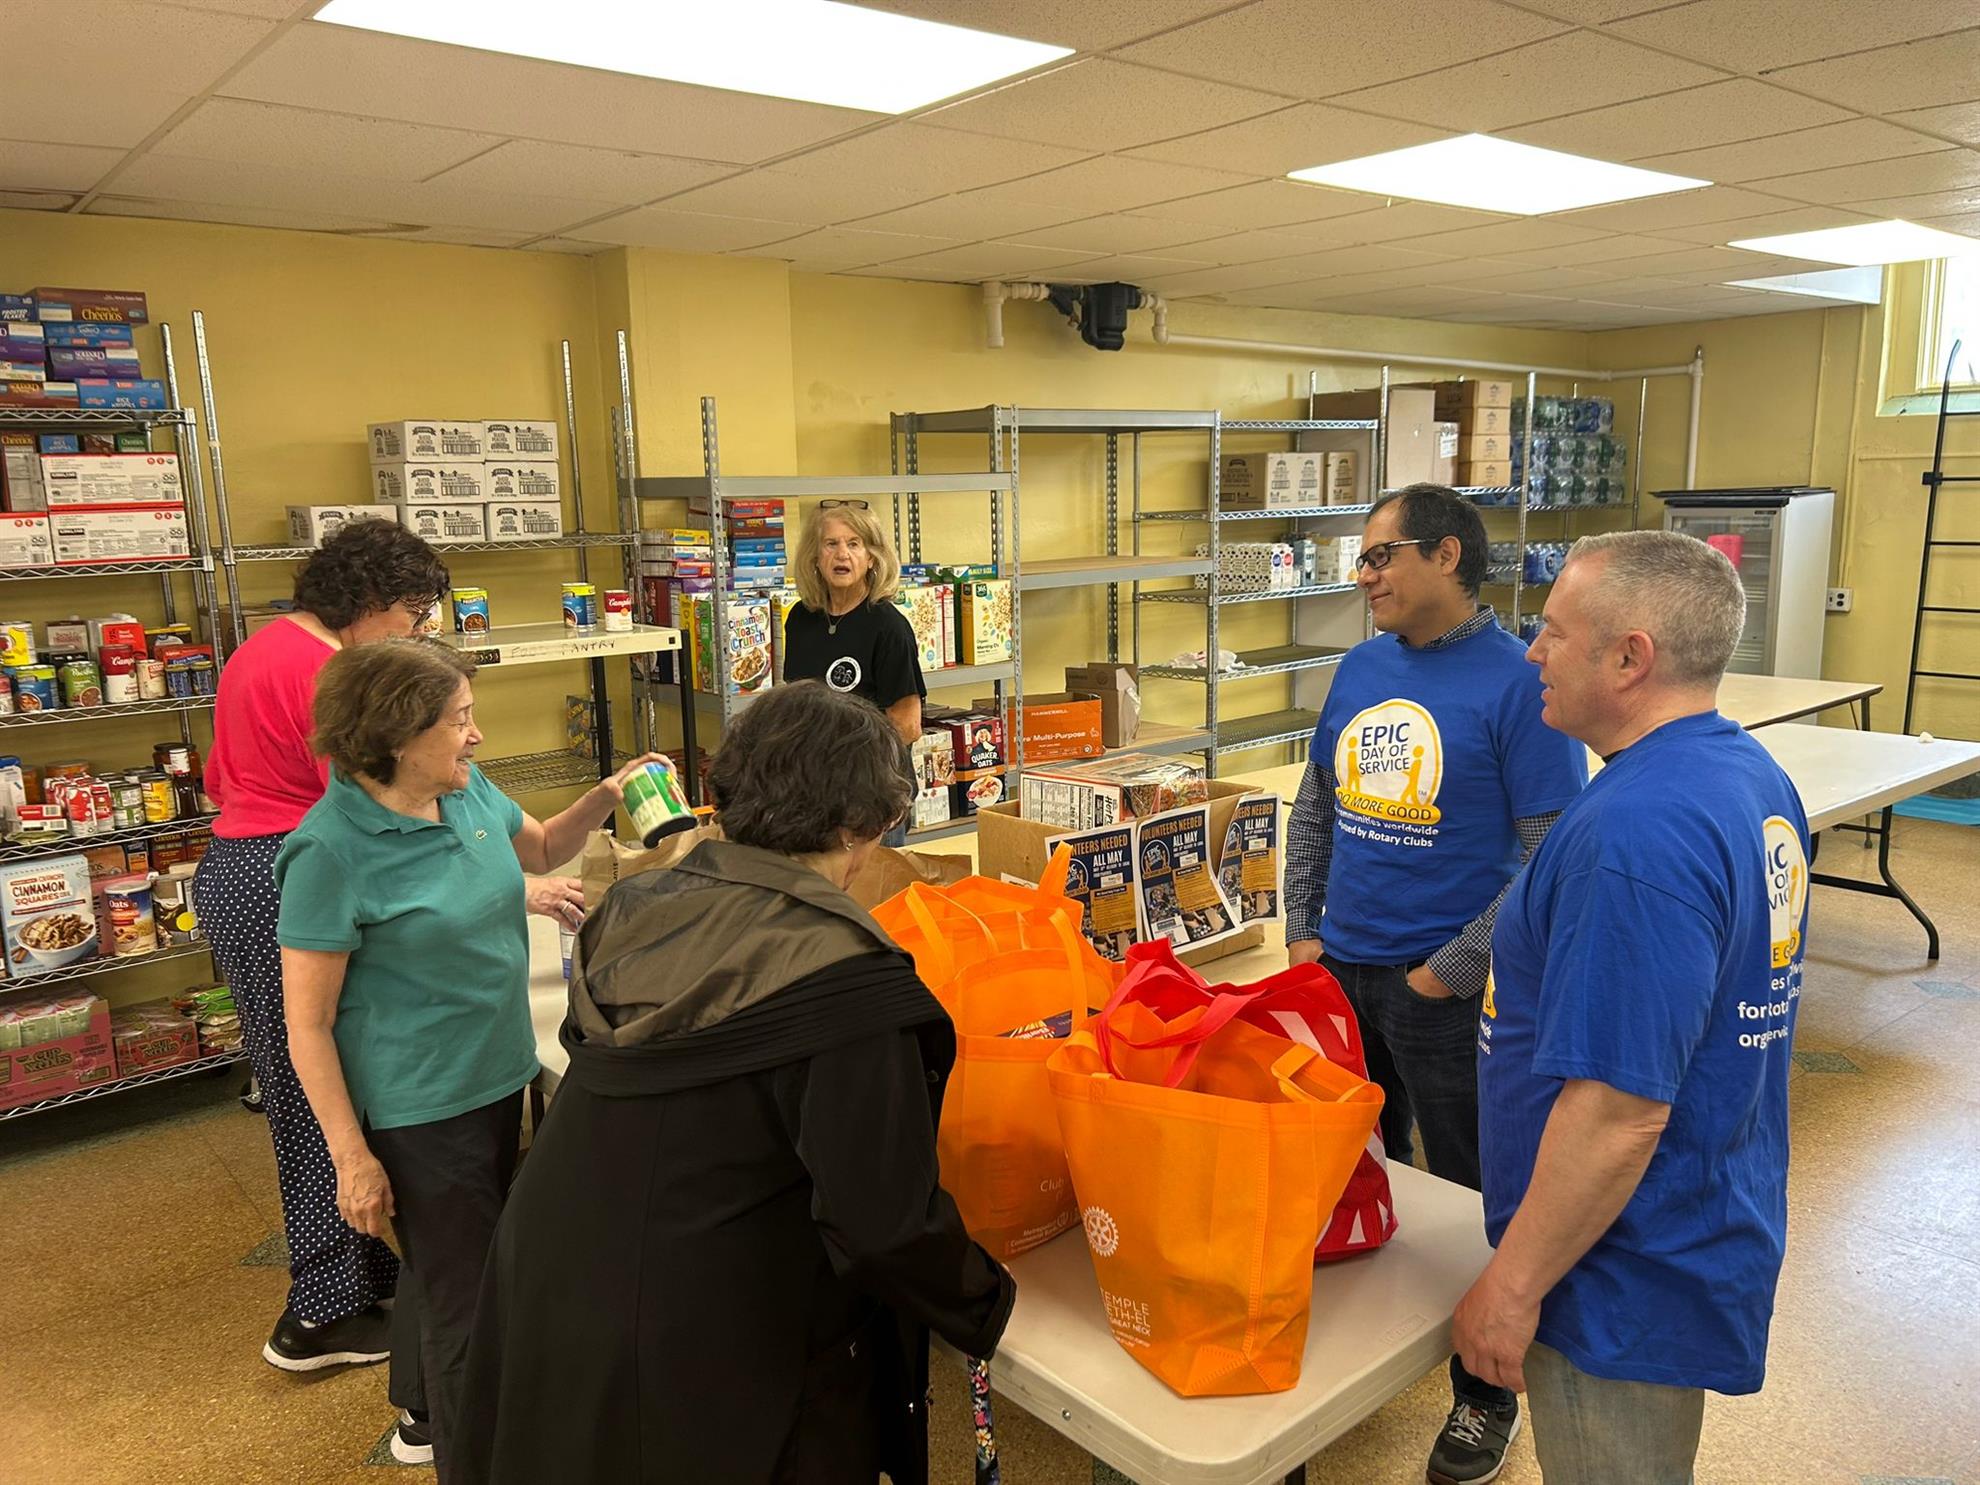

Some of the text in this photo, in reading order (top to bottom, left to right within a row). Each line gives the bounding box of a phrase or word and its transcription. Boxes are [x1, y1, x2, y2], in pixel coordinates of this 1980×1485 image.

[81, 308, 123, 321] Cheerios
[728, 613, 765, 629] Cinnamon
[733, 622, 760, 637] Toast
[561, 640, 616, 656] PANTRY
[730, 629, 766, 651] Crunch
[1033, 731, 1086, 742] Multi-Purpose
[1361, 722, 1410, 747] EPIC
[971, 751, 998, 762] QUAKER
[1362, 744, 1408, 761] DAY OF
[978, 760, 993, 768] OATS
[1359, 758, 1410, 775] SERVICE
[1252, 803, 1274, 816] NEEDED
[1351, 796, 1385, 814] MORE
[1387, 804, 1432, 820] GOOD
[1179, 815, 1203, 831] NEEDED
[1244, 817, 1269, 830] ALL MAY
[1382, 822, 1439, 835] worldwide
[1100, 834, 1128, 851] NEEDED
[1173, 830, 1198, 848] ALL MAY
[1368, 830, 1400, 846] Rotary
[1403, 836, 1433, 847] Clubs
[1093, 850, 1123, 867] ALL MAY
[1767, 842, 1789, 875] IC
[12, 881, 66, 898] CINNAMON
[15, 892, 60, 905] SQUARES
[109, 900, 129, 909] Oats
[1105, 1303, 1151, 1328] ETH-EL
